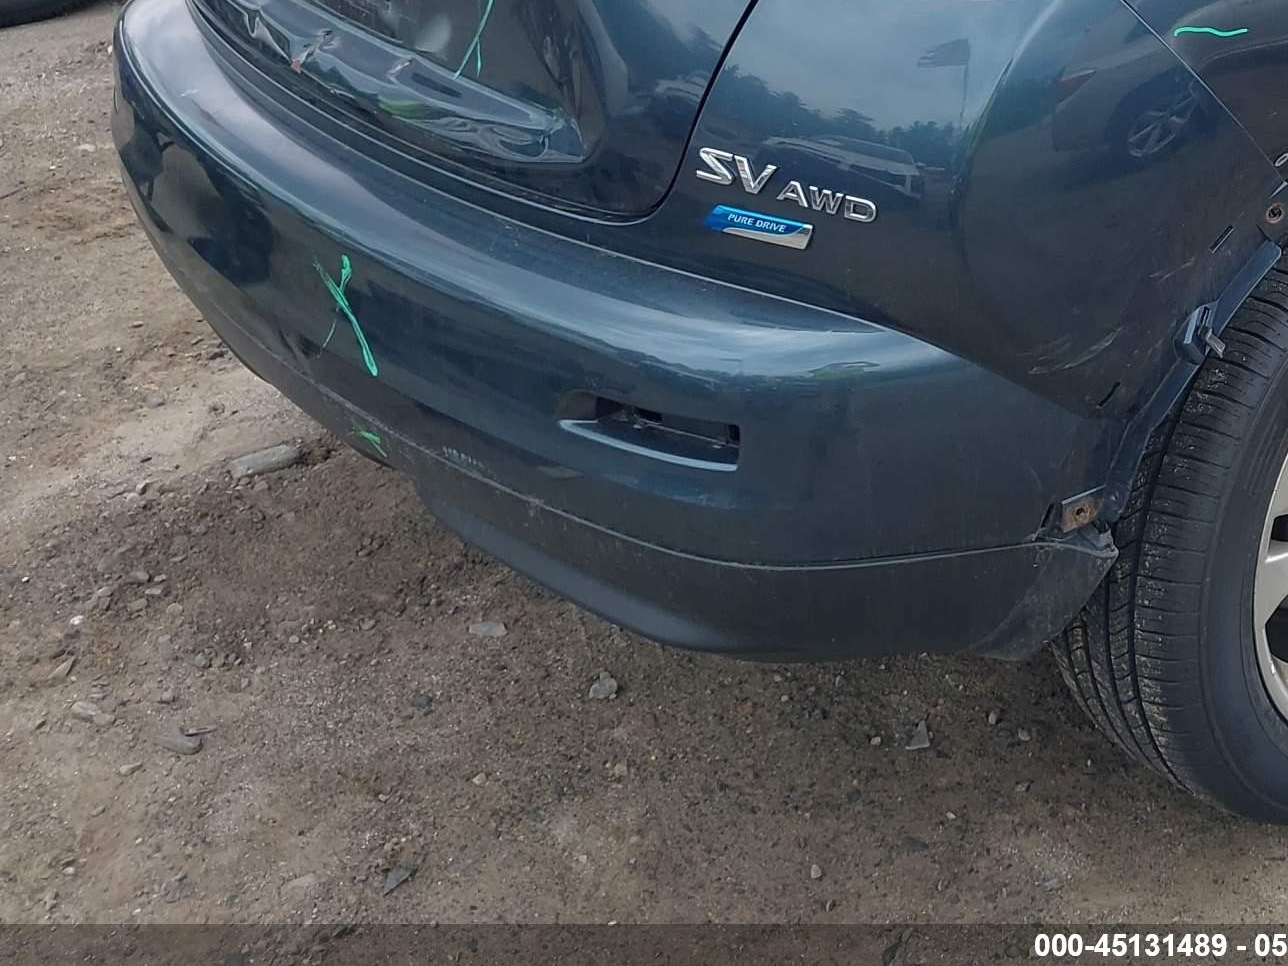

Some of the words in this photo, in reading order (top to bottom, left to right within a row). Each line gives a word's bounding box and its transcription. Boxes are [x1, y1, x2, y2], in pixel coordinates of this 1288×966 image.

[696, 147, 777, 194] SV
[776, 181, 877, 223] AWD
[727, 213, 753, 227] PURE
[755, 219, 788, 233] DRIVE
